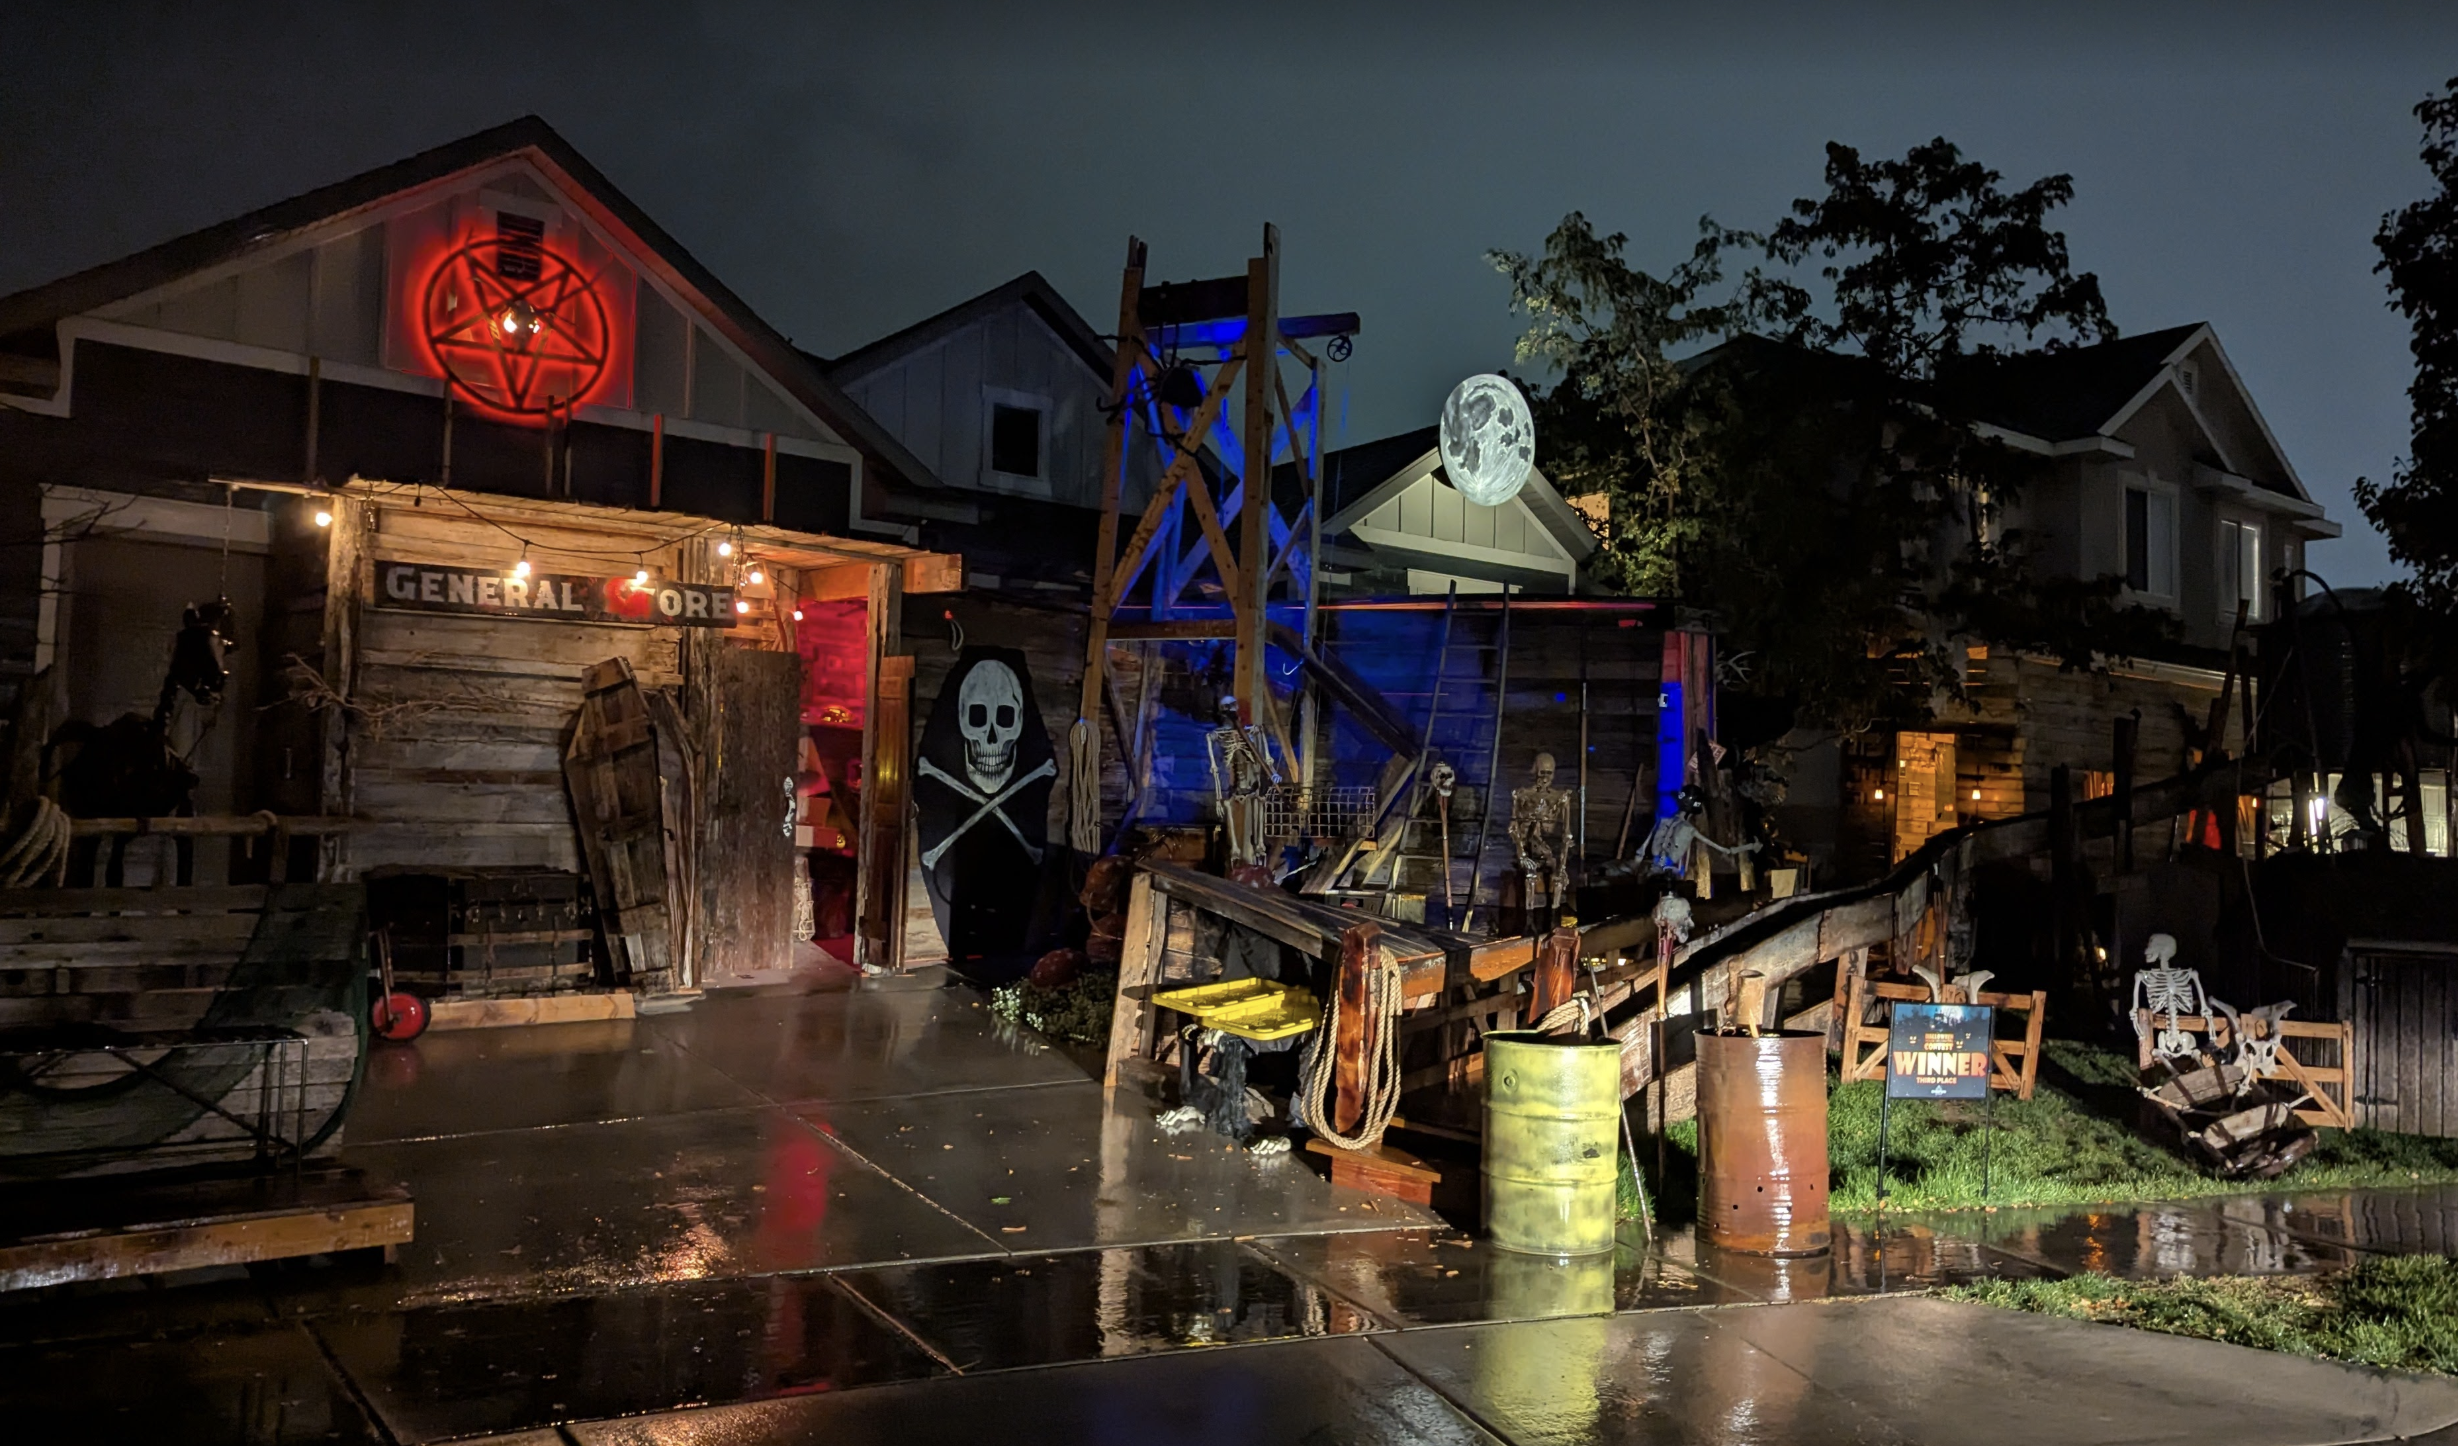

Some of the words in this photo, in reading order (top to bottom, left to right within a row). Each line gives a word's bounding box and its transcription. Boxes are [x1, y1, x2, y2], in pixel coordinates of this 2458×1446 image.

[385, 566, 583, 612] GENERAL
[1892, 1051, 1988, 1077] WINNER
[1916, 1076, 1936, 1084] THIRD
[1937, 1076, 1957, 1084] PLACE
